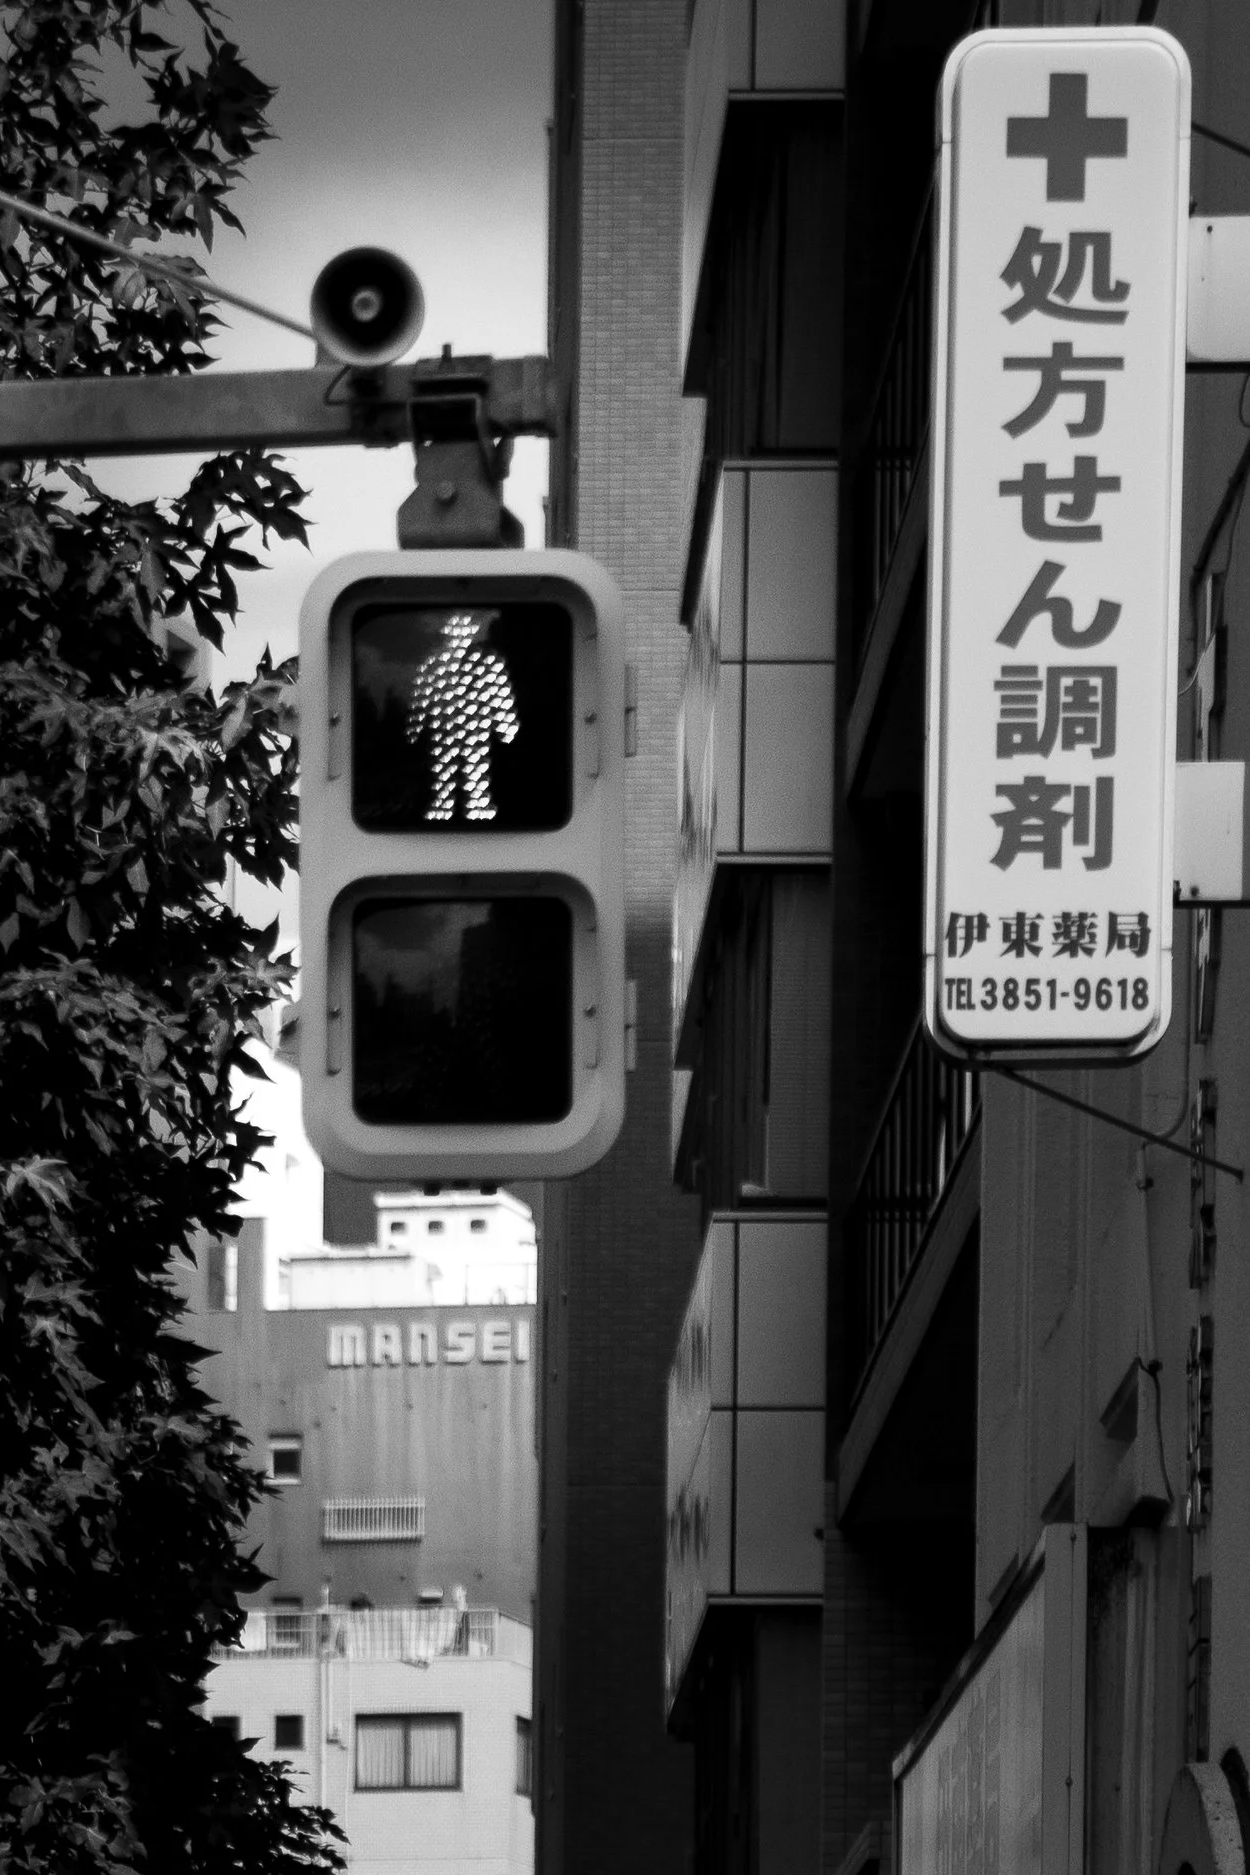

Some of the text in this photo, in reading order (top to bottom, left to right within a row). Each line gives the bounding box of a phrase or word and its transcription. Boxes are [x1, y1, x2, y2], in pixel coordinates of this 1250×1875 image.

[990, 226, 1130, 873] 処方せん調剤
[945, 911, 1151, 959] 伊東薬局
[327, 1318, 530, 1368] MANSEI
